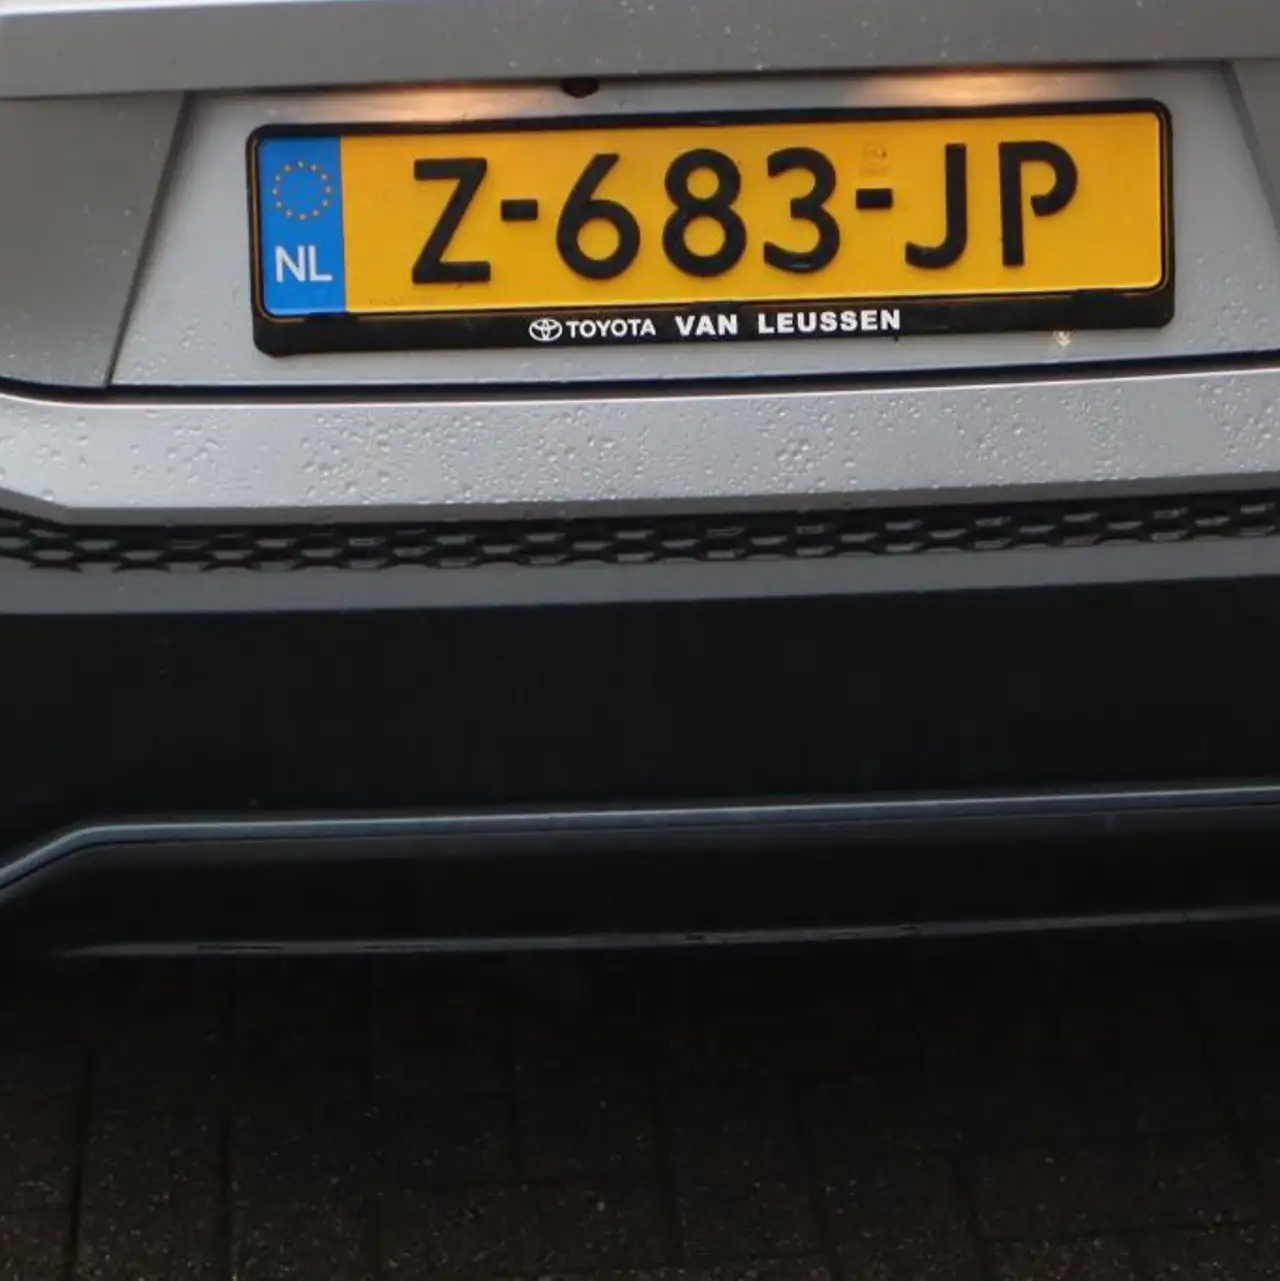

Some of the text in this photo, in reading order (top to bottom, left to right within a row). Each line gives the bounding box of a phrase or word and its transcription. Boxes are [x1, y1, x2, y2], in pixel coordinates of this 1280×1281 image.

[412, 140, 1078, 285] Z-683-JP
[274, 244, 333, 283] NL
[565, 309, 901, 339] TOYOTA VAN LEUSSEN
